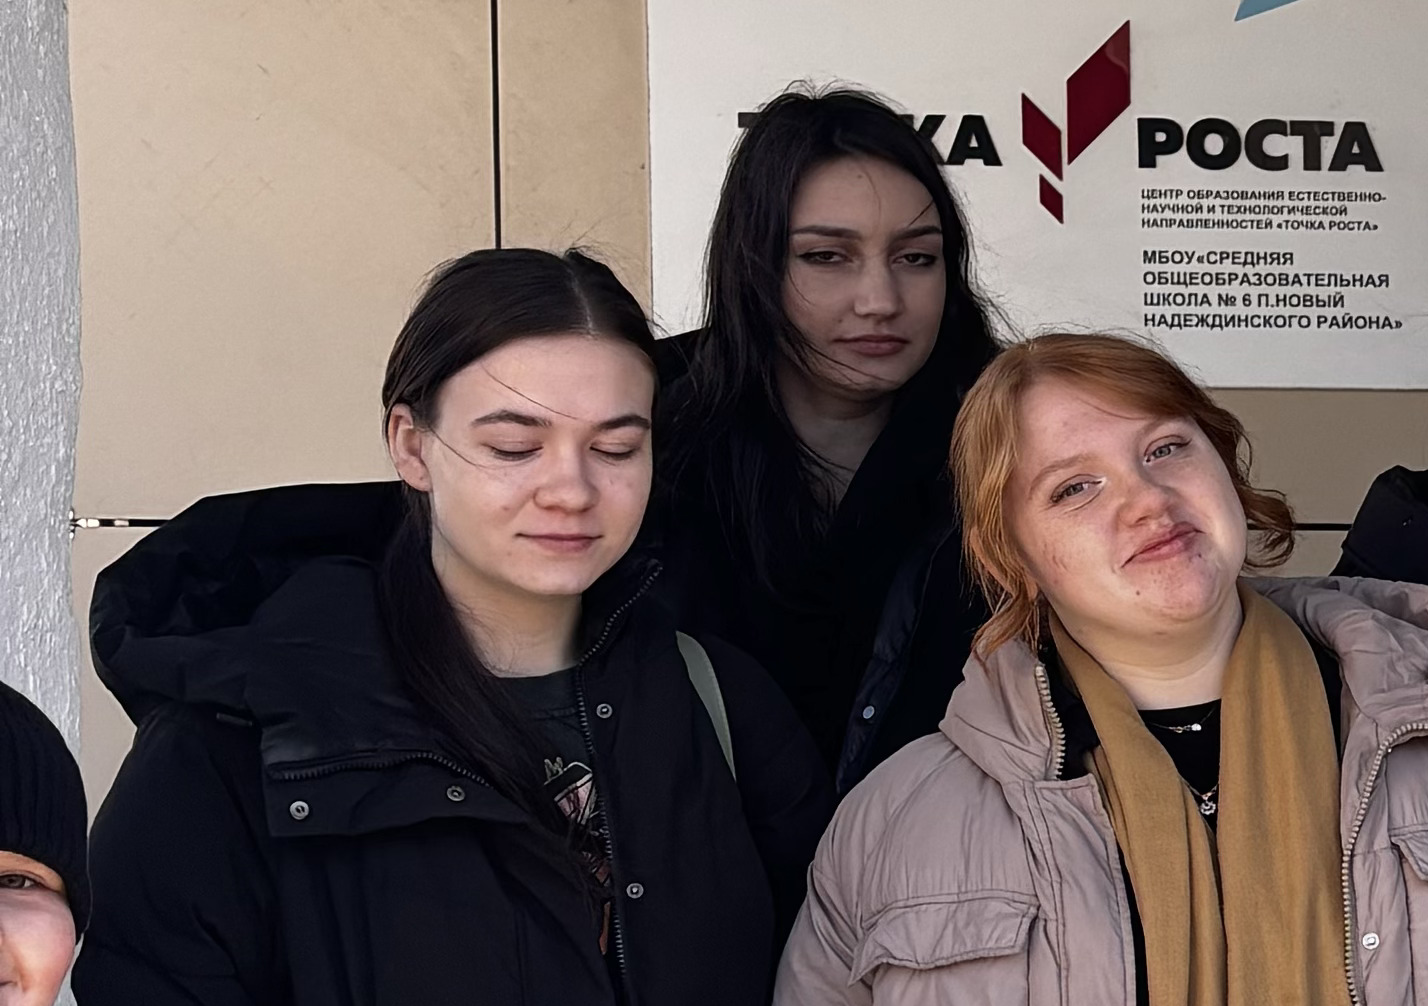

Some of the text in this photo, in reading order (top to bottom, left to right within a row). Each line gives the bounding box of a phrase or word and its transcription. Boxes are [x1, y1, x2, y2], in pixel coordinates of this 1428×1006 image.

[1137, 118, 1384, 172] РОСТА
[1141, 189, 1387, 202] ЦЕНТР ОБРАЗОВАНИЯ ЕСТЕСТВЕННО-
[1141, 203, 1348, 216] НАУЧНОЙ И ТЕХНОЛОГИЧЕСКОЙ
[1141, 218, 1379, 232] НАПРАВЛЕННОСТЕЙ «ТОЧКА РОСТА»
[1143, 271, 1390, 288] ОБЩЕОБРАЗОВАТЕЛЬНАЯ
[1144, 292, 1212, 307] ШКОЛА
[1217, 292, 1237, 307] №
[1243, 293, 1252, 307] 6
[1144, 313, 1403, 331] НАДЕЖДИНСКОГО РАЙОНА»
